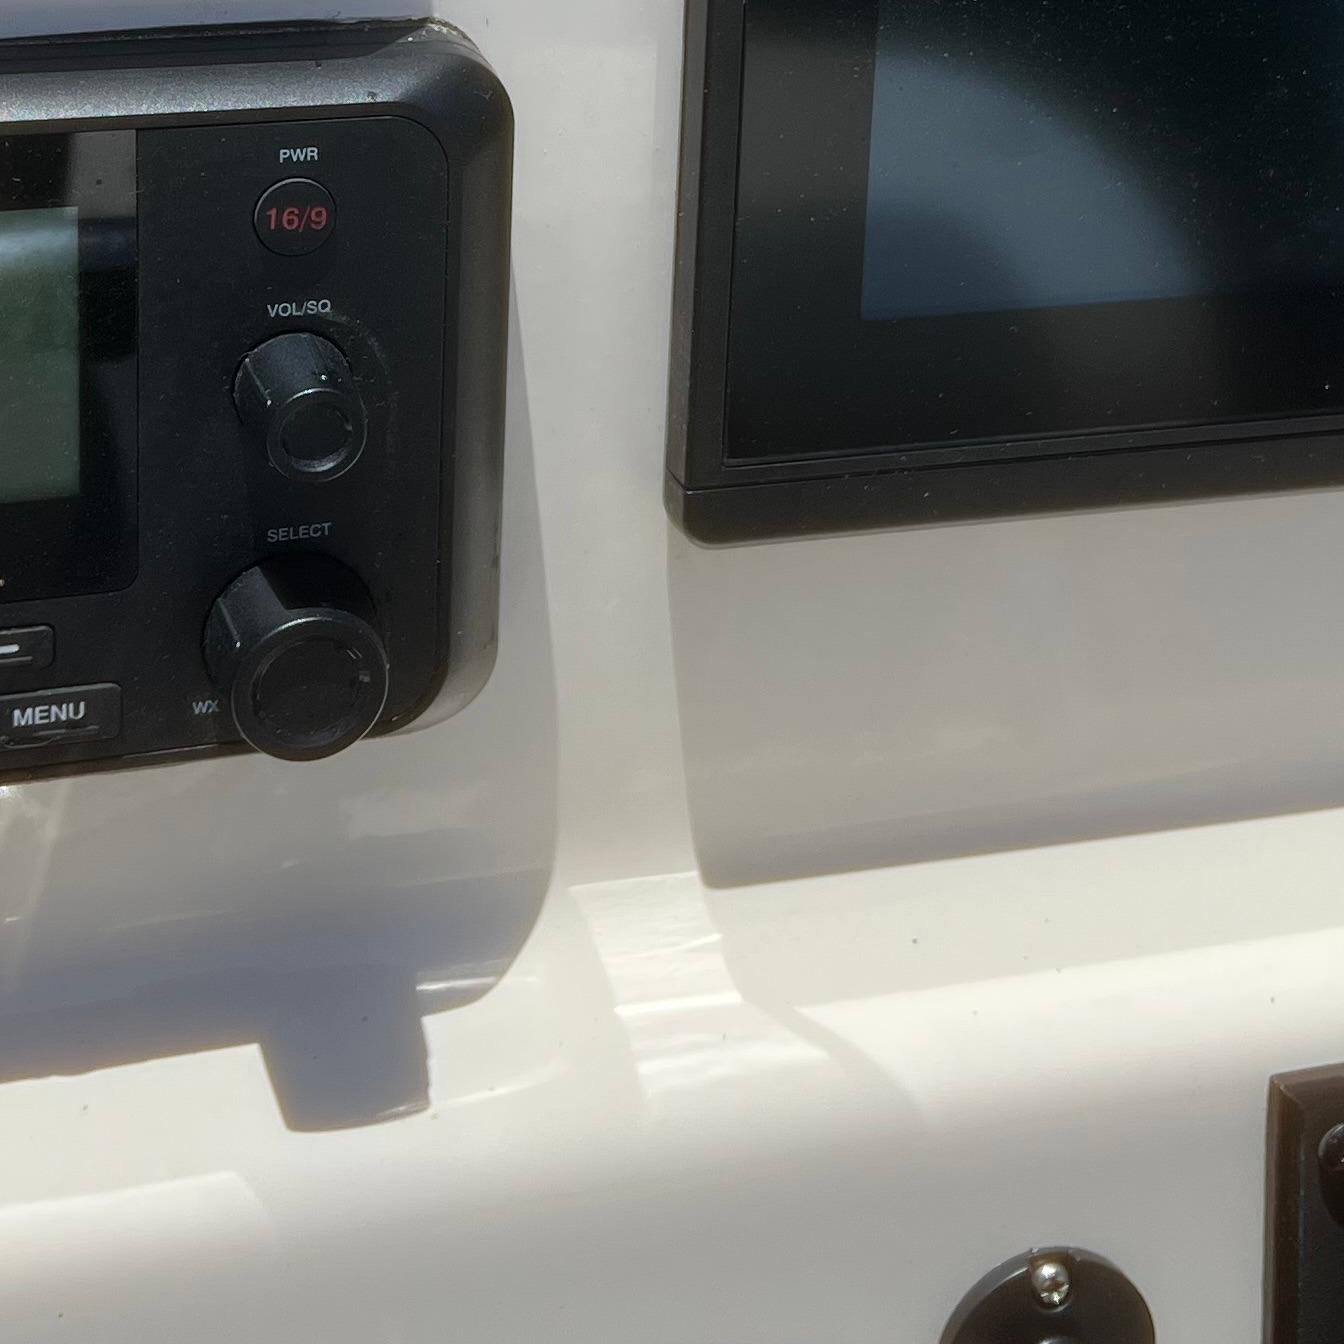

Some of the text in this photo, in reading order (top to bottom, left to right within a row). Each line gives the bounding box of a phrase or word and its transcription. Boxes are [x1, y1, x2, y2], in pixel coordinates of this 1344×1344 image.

[278, 146, 319, 164] PWR
[266, 207, 328, 233] 16/9
[267, 298, 333, 318] VOL/SQ
[267, 521, 333, 543] SELECT
[12, 701, 86, 728] MENU
[192, 699, 220, 715] WX
